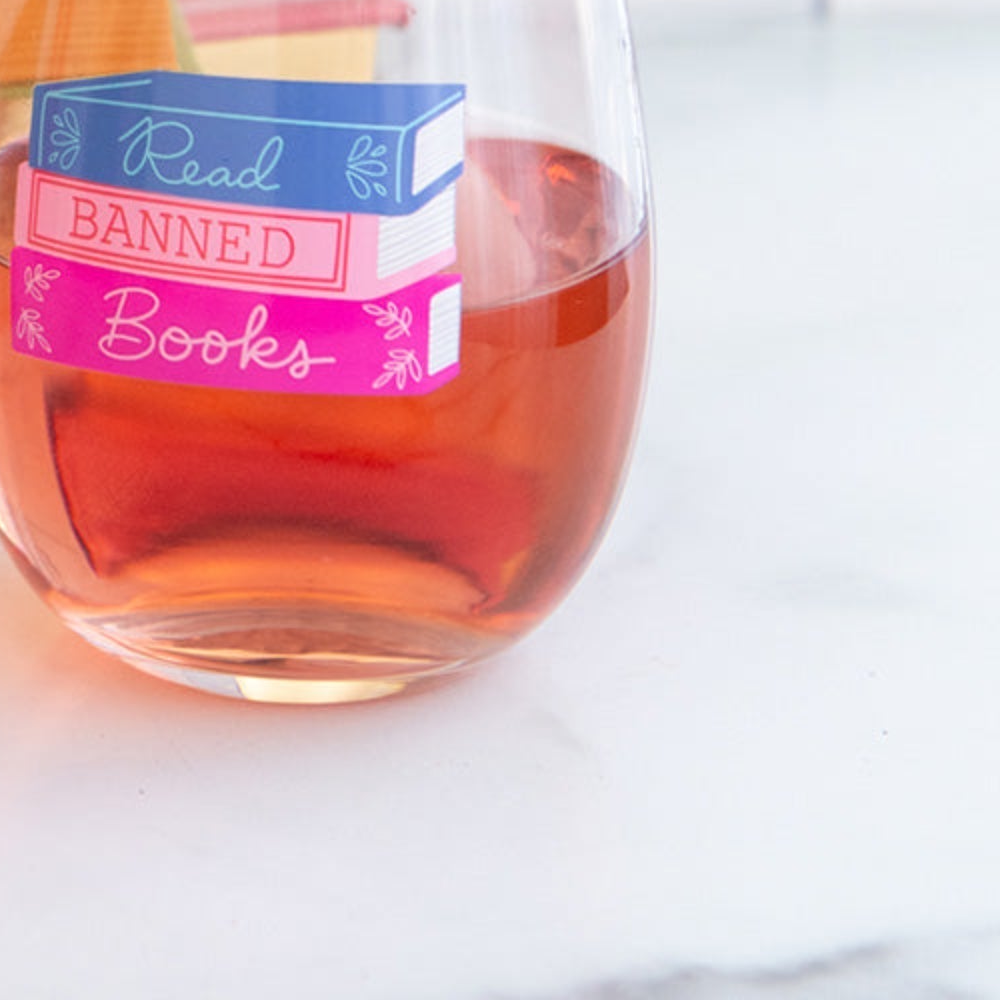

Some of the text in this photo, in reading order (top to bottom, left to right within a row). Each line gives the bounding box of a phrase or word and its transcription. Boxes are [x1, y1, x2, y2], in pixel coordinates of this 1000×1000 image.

[118, 117, 284, 190] Read
[69, 197, 296, 269] BANNED
[98, 287, 335, 378] Books
